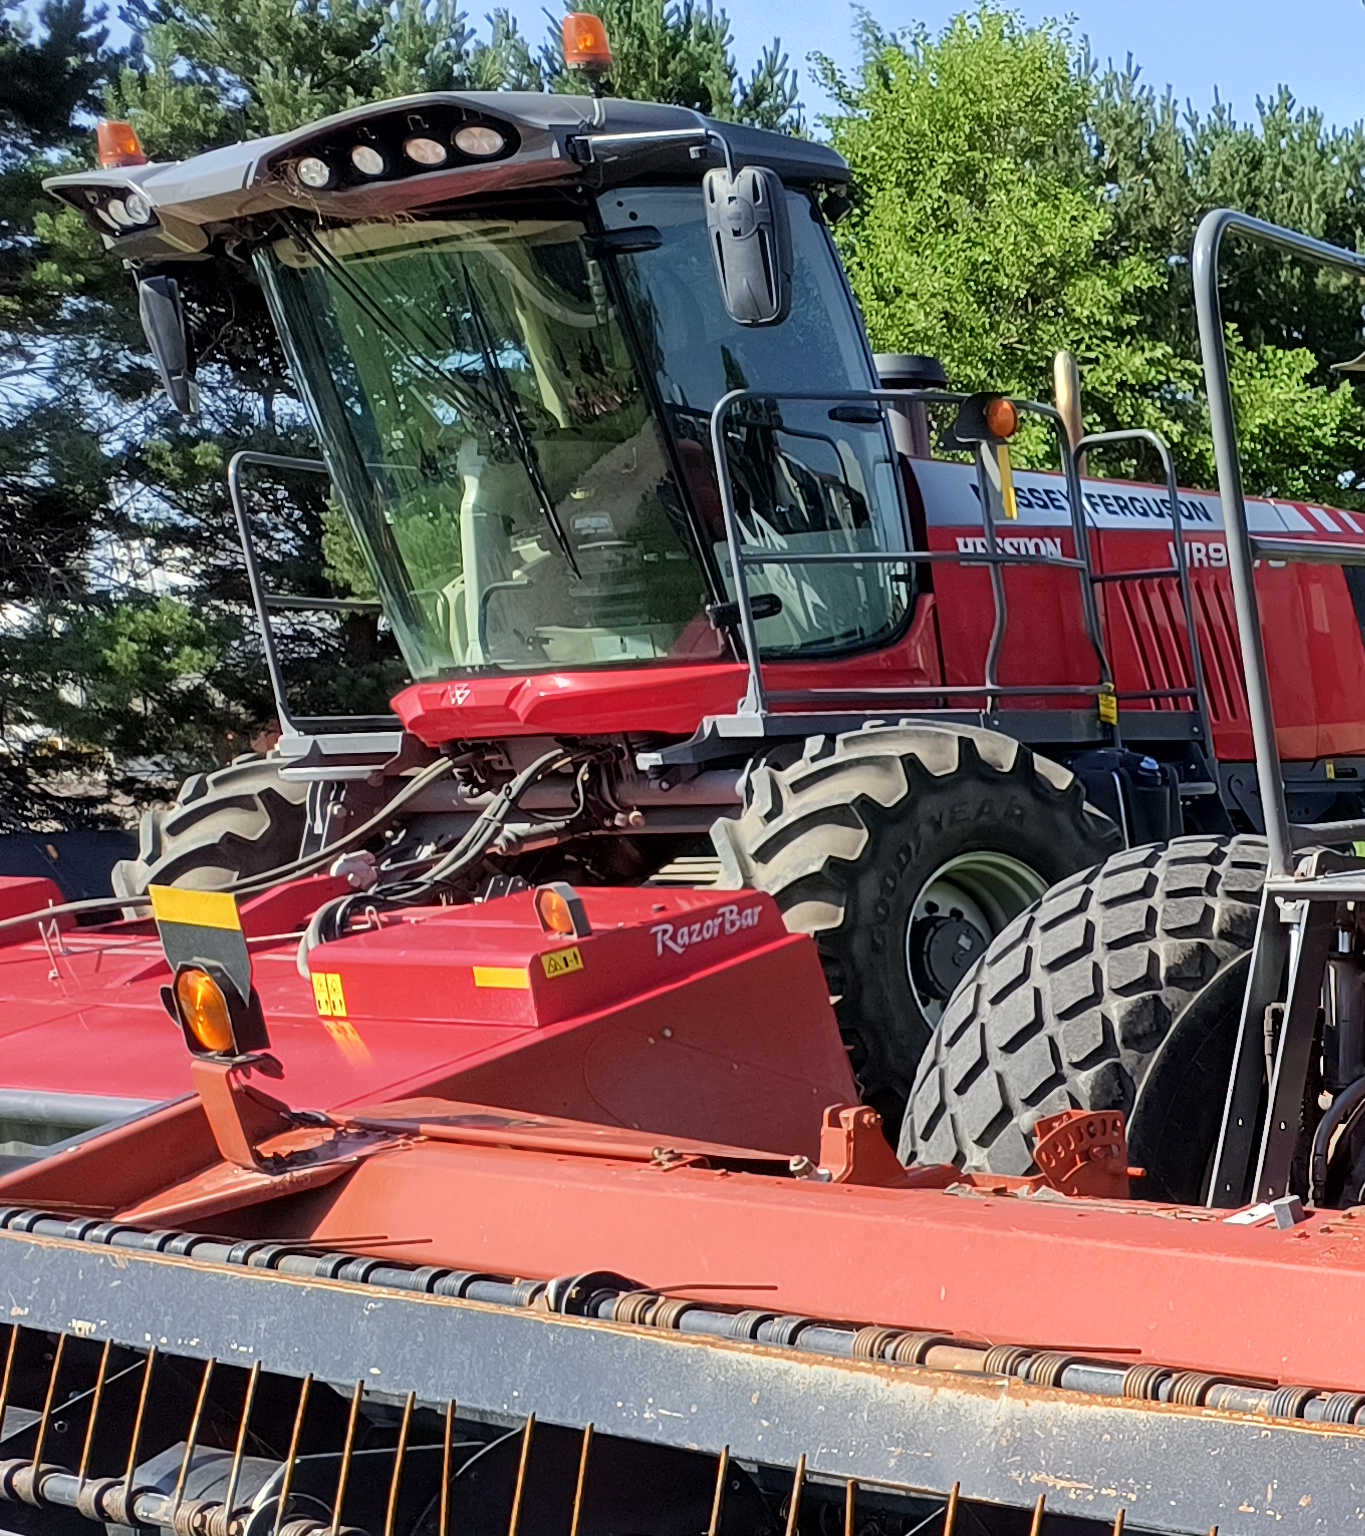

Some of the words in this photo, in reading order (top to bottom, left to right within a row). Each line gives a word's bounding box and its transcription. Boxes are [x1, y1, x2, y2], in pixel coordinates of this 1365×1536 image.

[969, 483, 1070, 511] SSEY
[1084, 492, 1213, 523] FERGUSON
[1168, 541, 1286, 568] WR9
[650, 904, 763, 957] RazorBar
